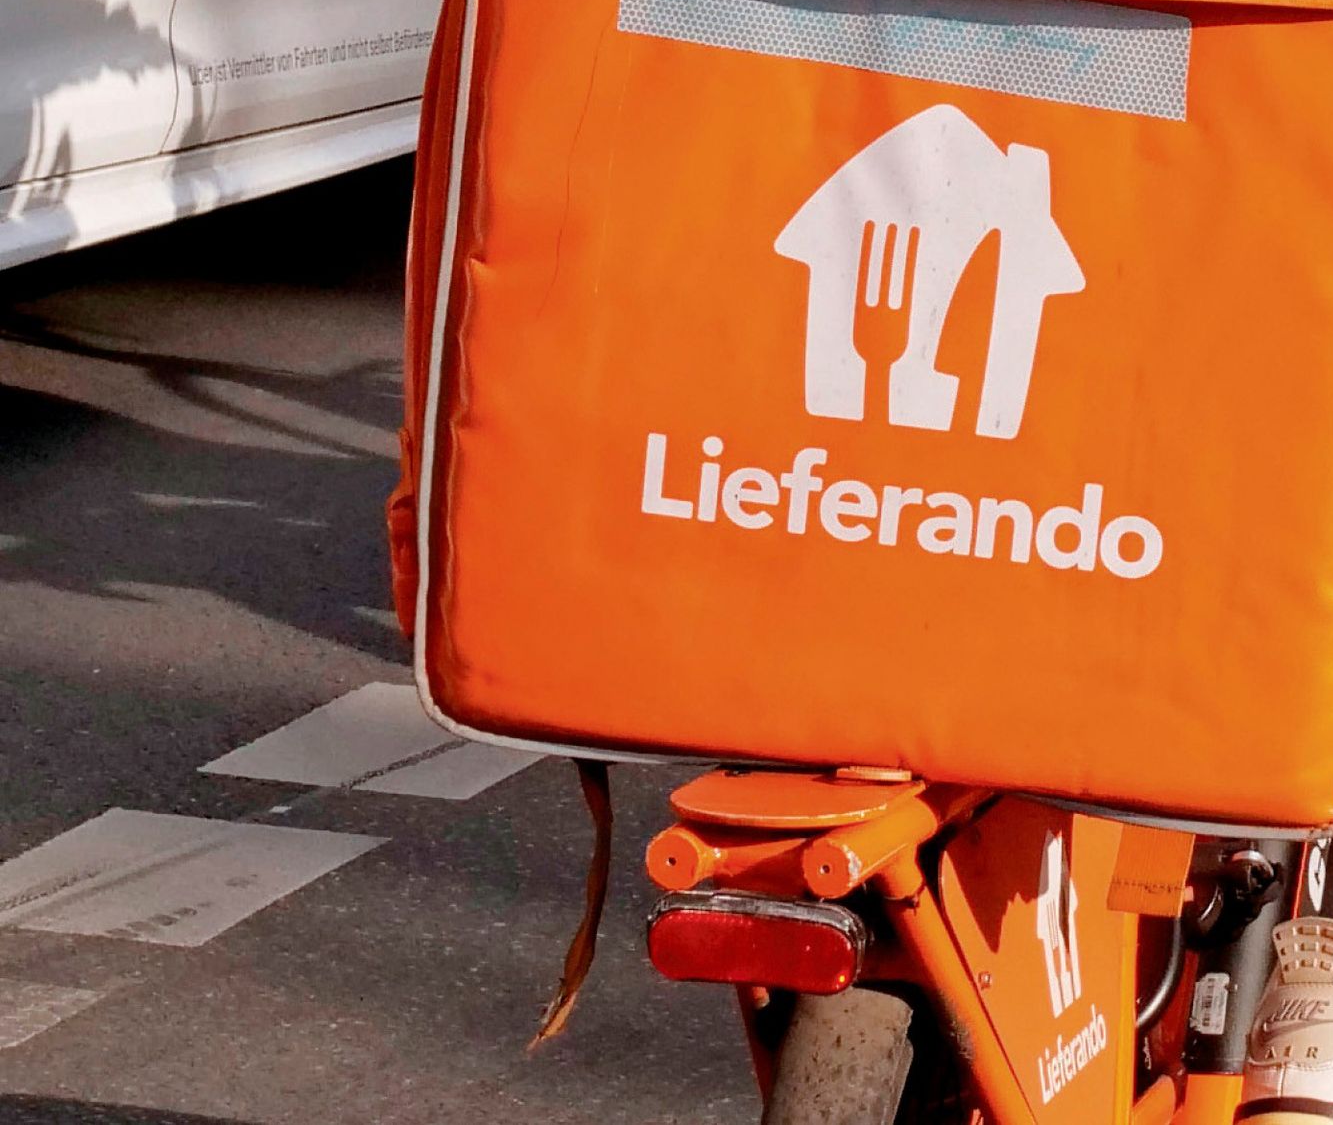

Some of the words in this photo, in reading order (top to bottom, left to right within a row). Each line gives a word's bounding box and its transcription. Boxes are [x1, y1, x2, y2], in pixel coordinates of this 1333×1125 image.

[641, 432, 1164, 580] Lieferando
[1038, 1003, 1107, 1105] Lieferando
[1264, 1045, 1318, 1059] AIR
